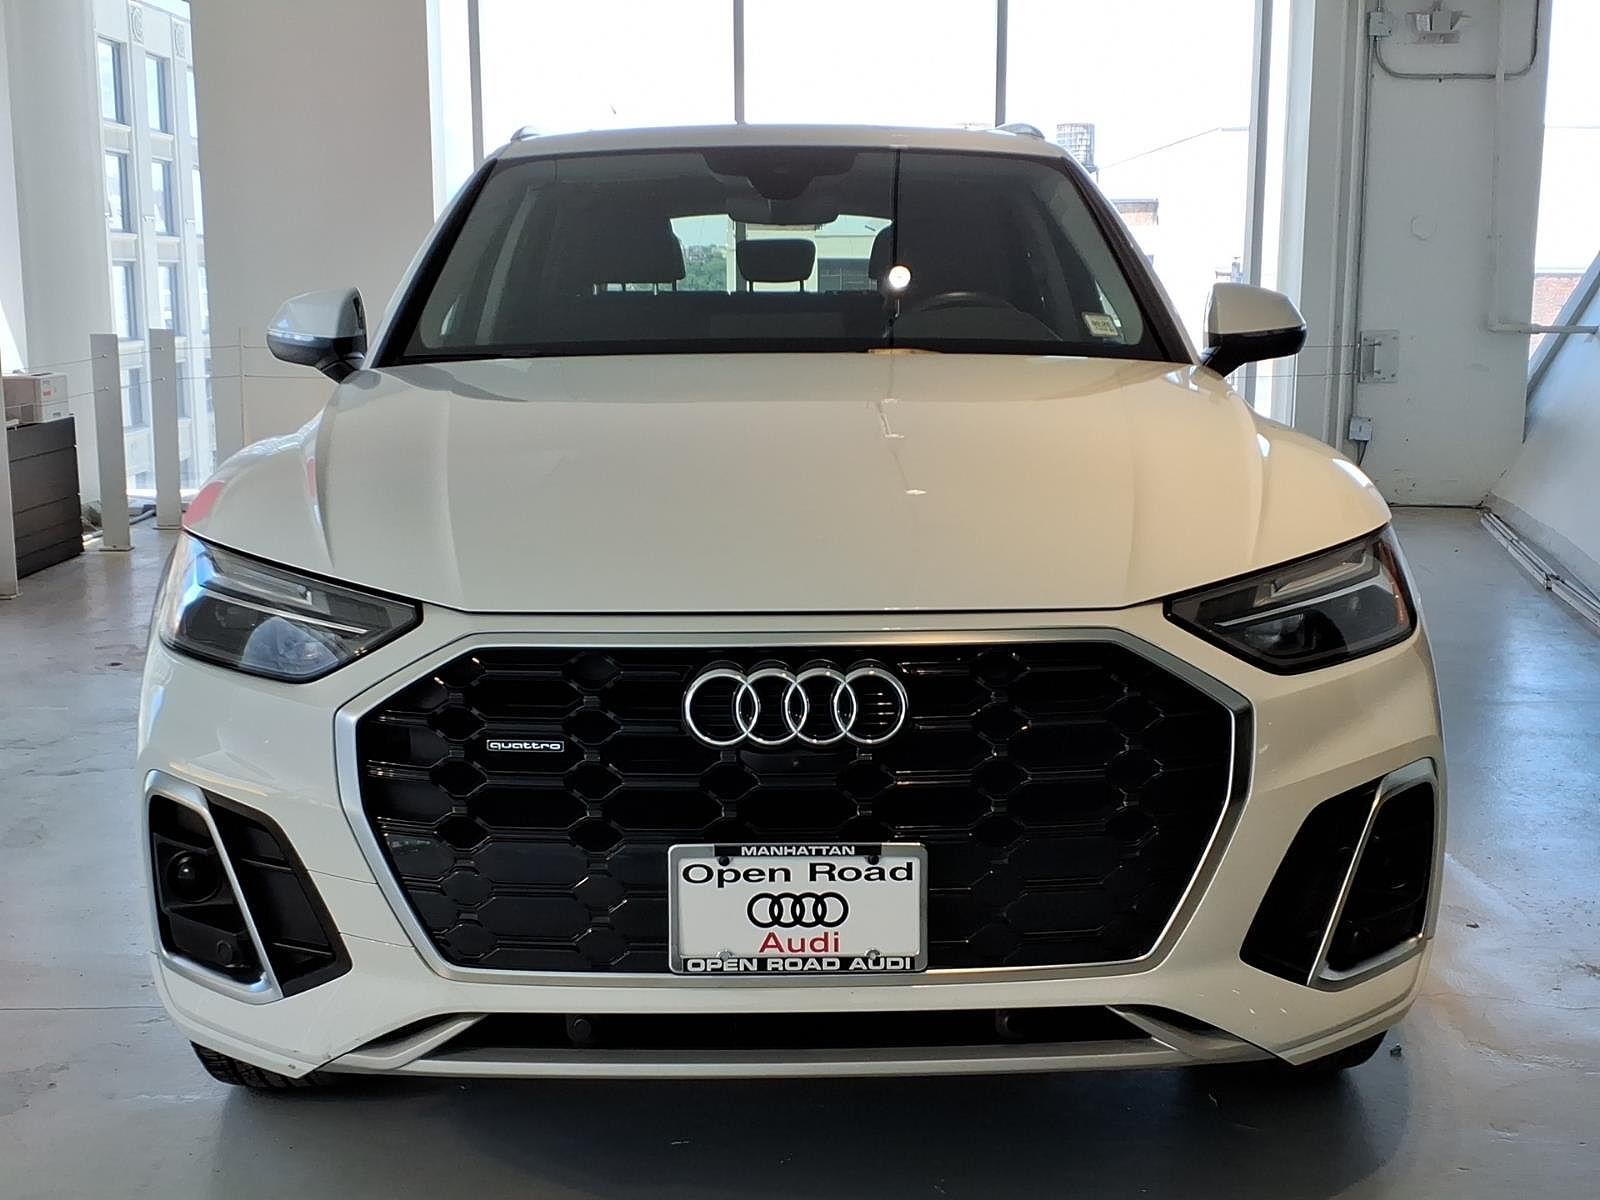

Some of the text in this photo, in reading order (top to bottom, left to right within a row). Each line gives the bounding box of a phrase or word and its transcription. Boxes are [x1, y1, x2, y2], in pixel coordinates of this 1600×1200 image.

[489, 742, 561, 750] quattro
[740, 845, 856, 856] MANHATTAN
[682, 861, 914, 889] Open Road
[758, 931, 841, 954] Audi
[686, 956, 912, 972] OPEN ROAD AUDI
